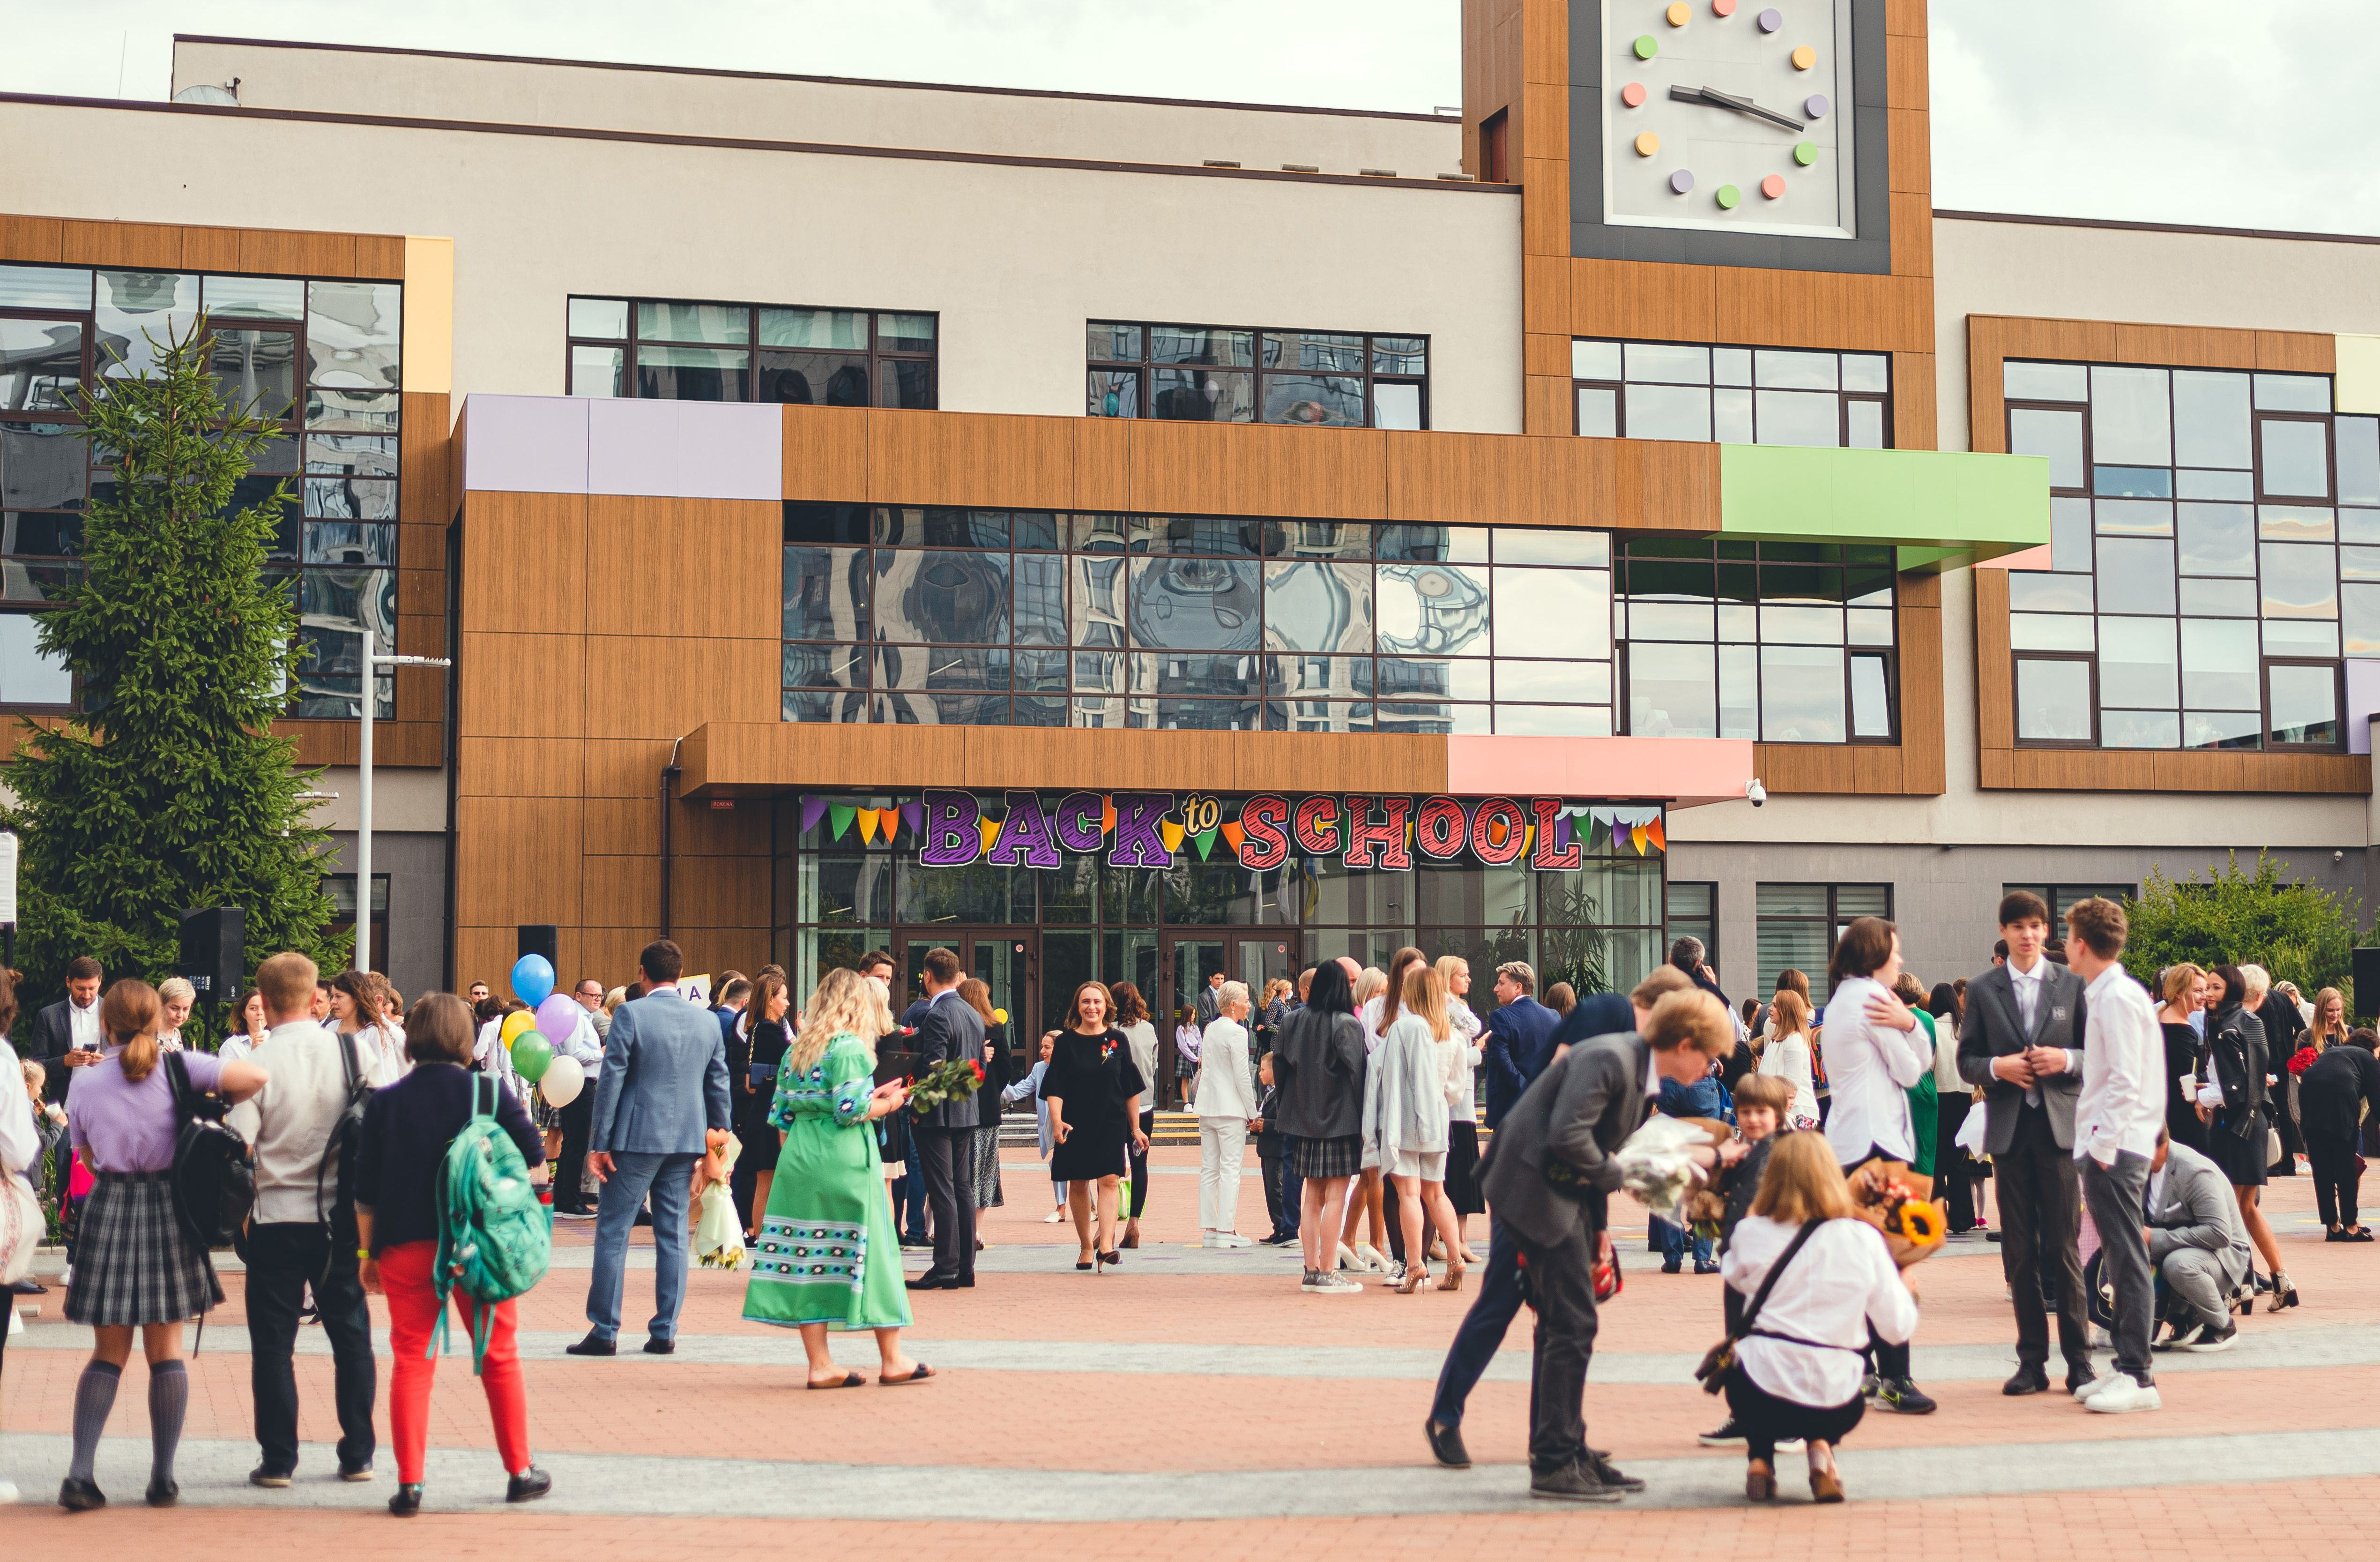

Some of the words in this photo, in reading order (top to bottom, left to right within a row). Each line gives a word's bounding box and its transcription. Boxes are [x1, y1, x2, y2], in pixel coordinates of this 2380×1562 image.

[920, 790, 1174, 869] BACK
[1182, 793, 1222, 837] to
[1239, 794, 1582, 871] SCHOOL
